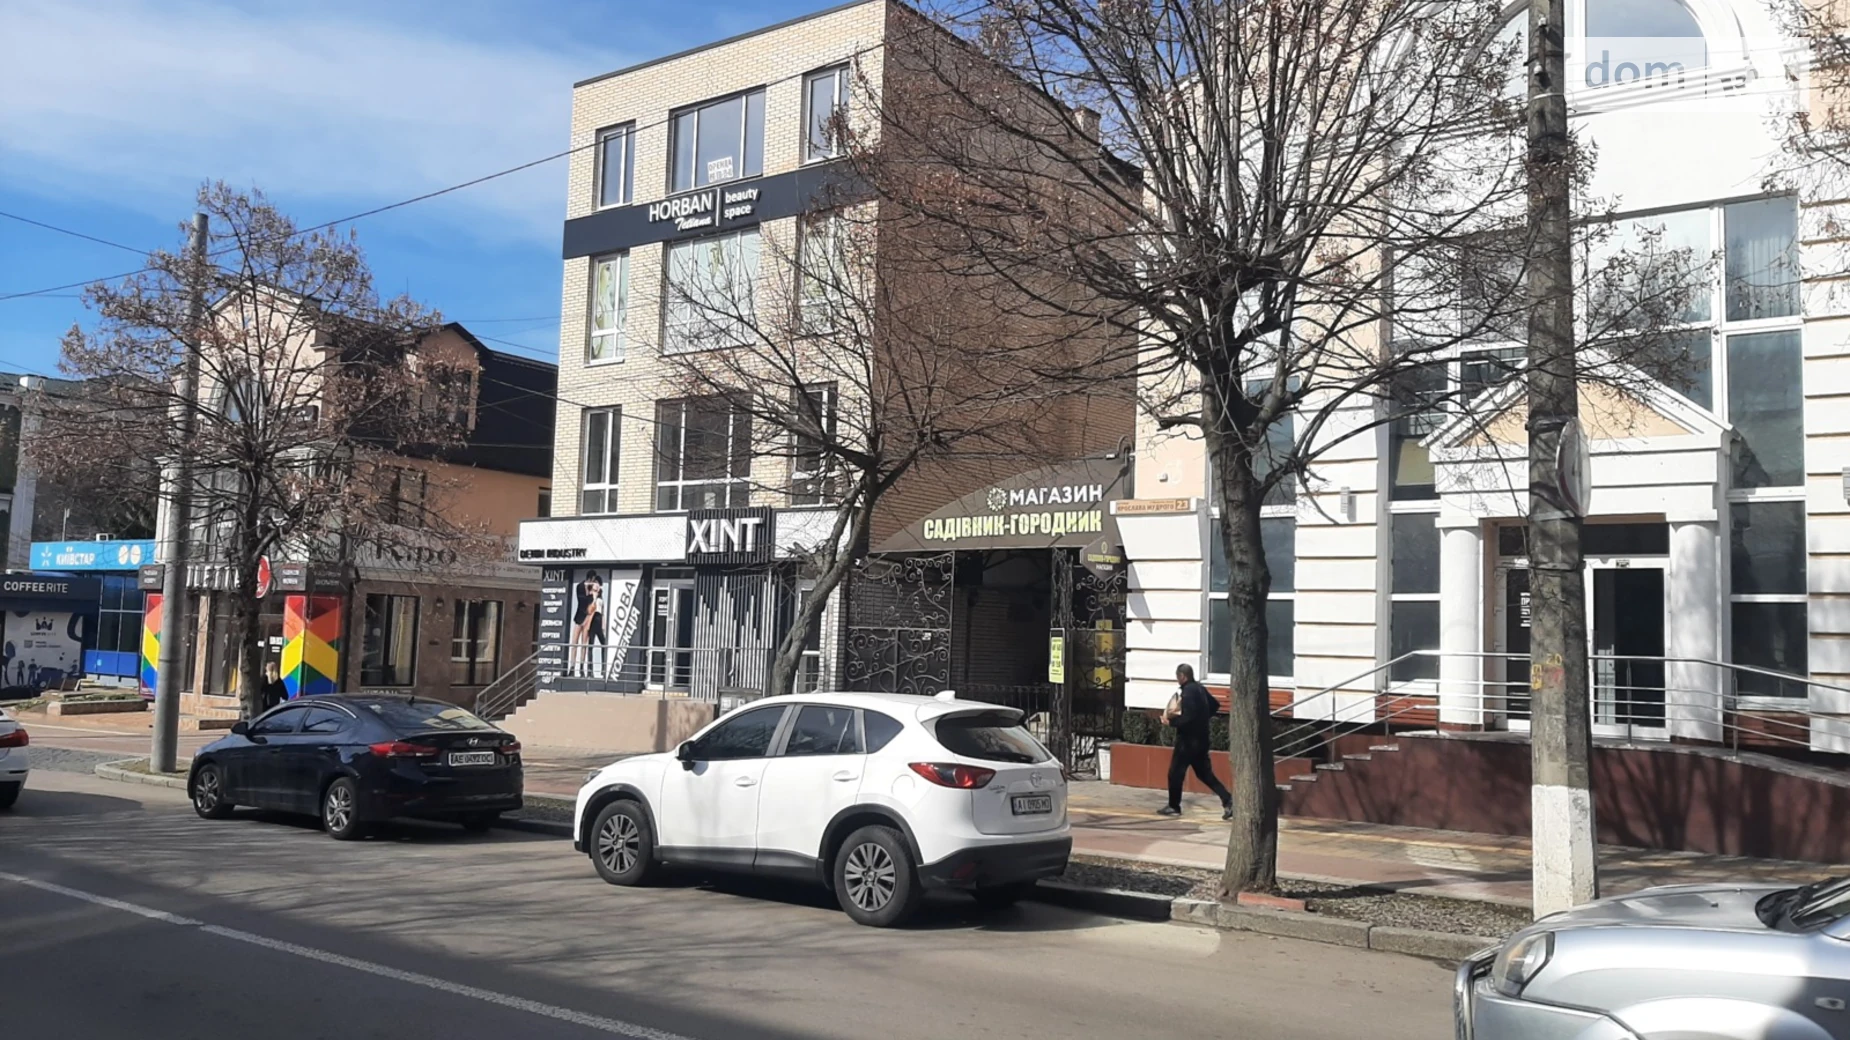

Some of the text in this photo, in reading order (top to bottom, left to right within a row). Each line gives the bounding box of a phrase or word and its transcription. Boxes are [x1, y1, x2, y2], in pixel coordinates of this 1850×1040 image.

[649, 192, 713, 222] HORBAN
[725, 188, 759, 204] beauty
[724, 204, 752, 219] space
[1009, 484, 1103, 507] МАГАЗИН
[1176, 500, 1188, 510] 23
[688, 517, 764, 554] XINT
[923, 509, 1103, 542] САДІВНИК-ГОРОДНИК
[56, 546, 96, 566] КИЇВСТАР
[546, 547, 587, 559] INDUSTRY
[611, 581, 636, 636] НОВА
[610, 605, 641, 682] КОЛЕКЦІЯ
